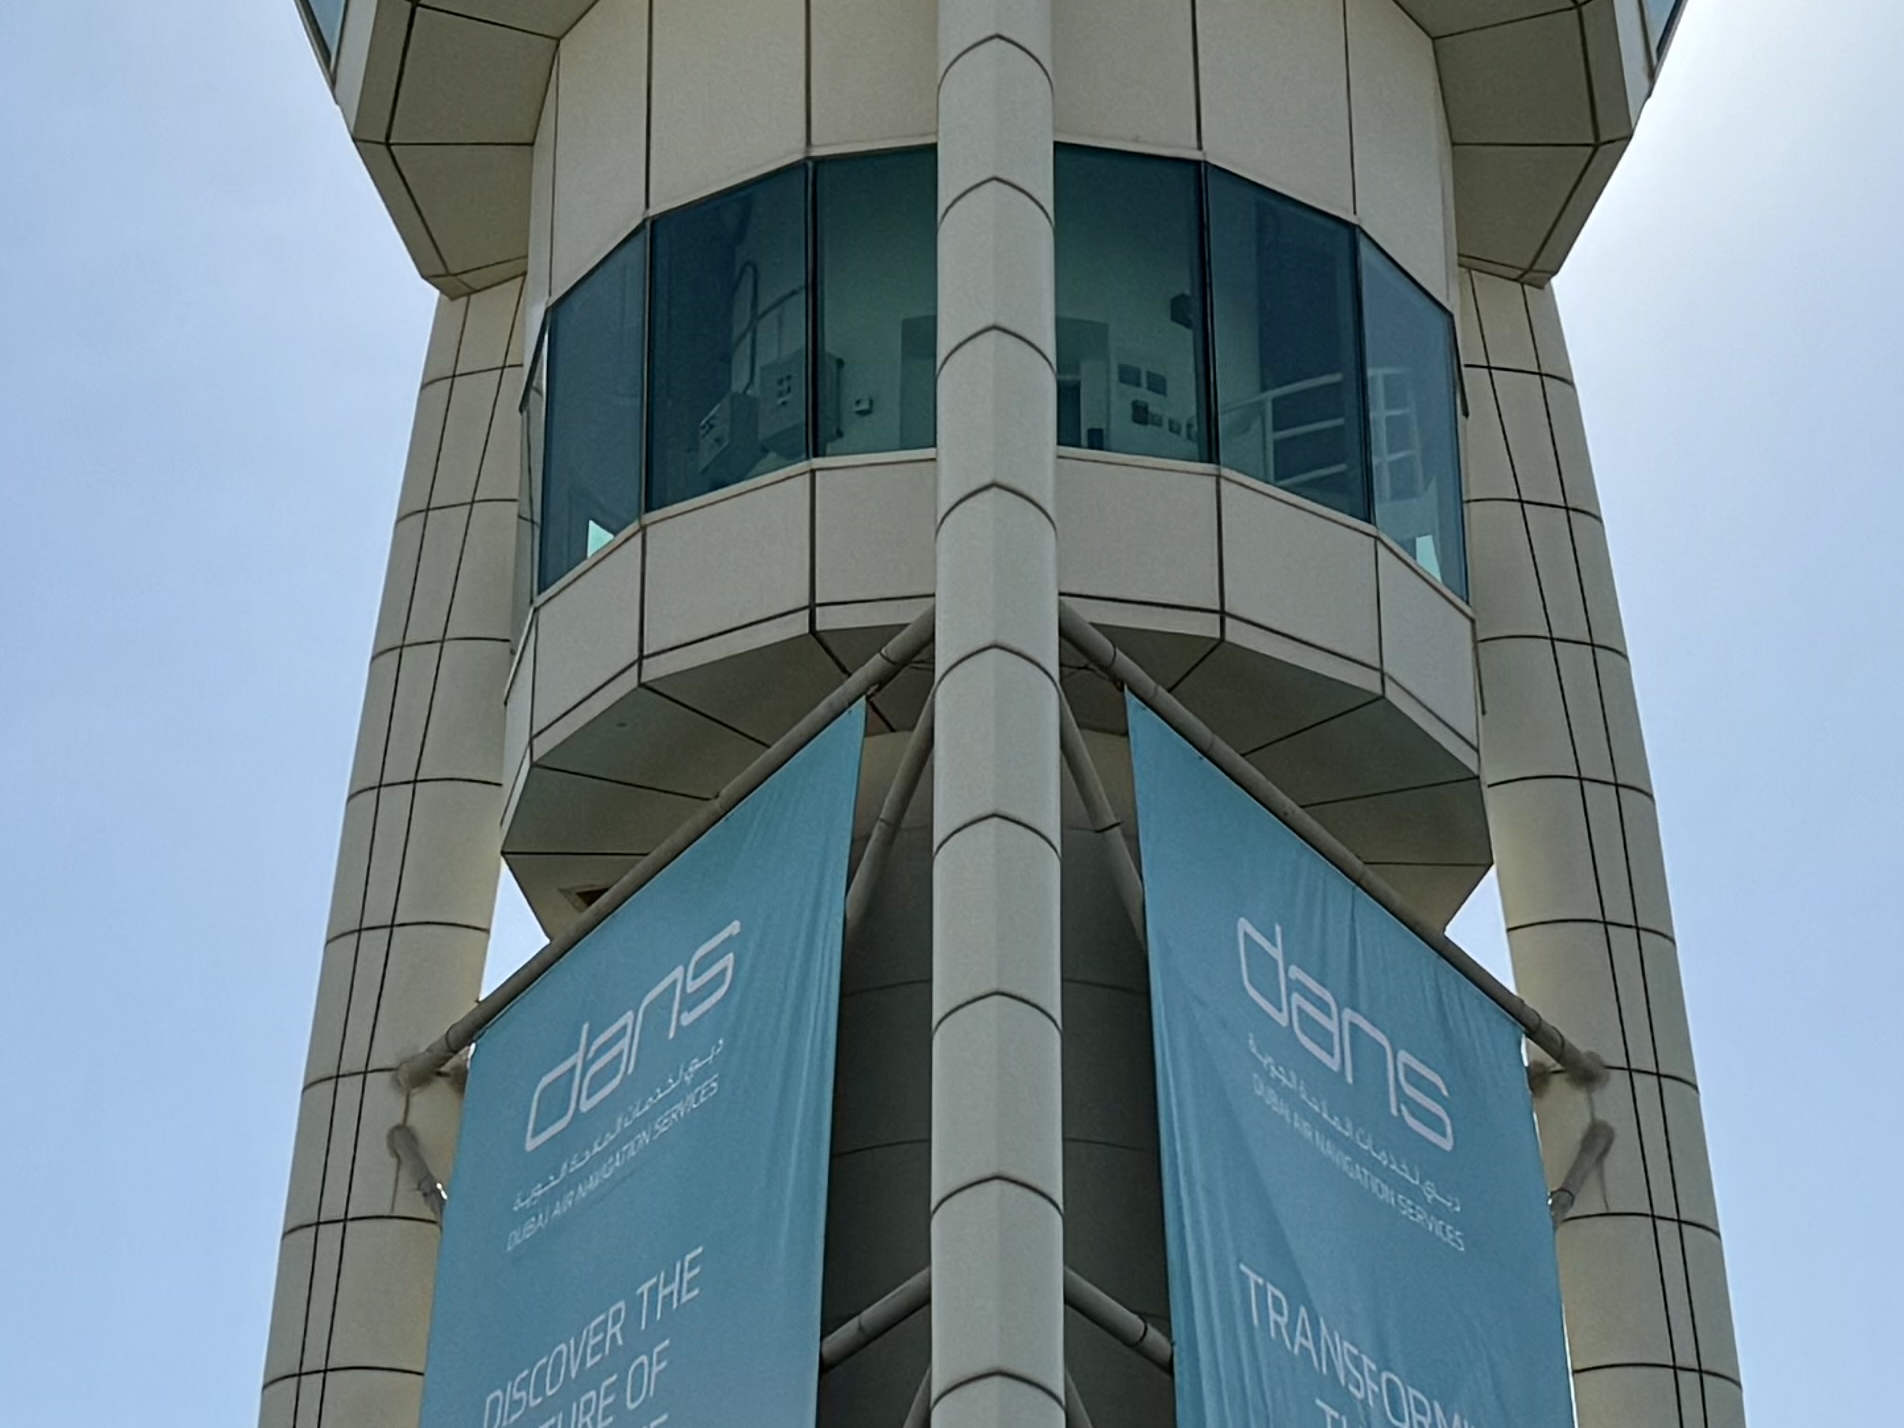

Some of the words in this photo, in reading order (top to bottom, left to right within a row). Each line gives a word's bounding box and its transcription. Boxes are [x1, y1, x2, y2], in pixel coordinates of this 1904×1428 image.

[525, 920, 741, 1152] dans
[1237, 917, 1454, 1152] dans
[507, 1211, 548, 1252] DUBAI
[552, 1188, 574, 1218] AIR
[653, 1072, 719, 1139] SERVICES
[1397, 1193, 1465, 1252] SERVICES
[636, 1246, 703, 1330] THE
[626, 1339, 671, 1410] OF
